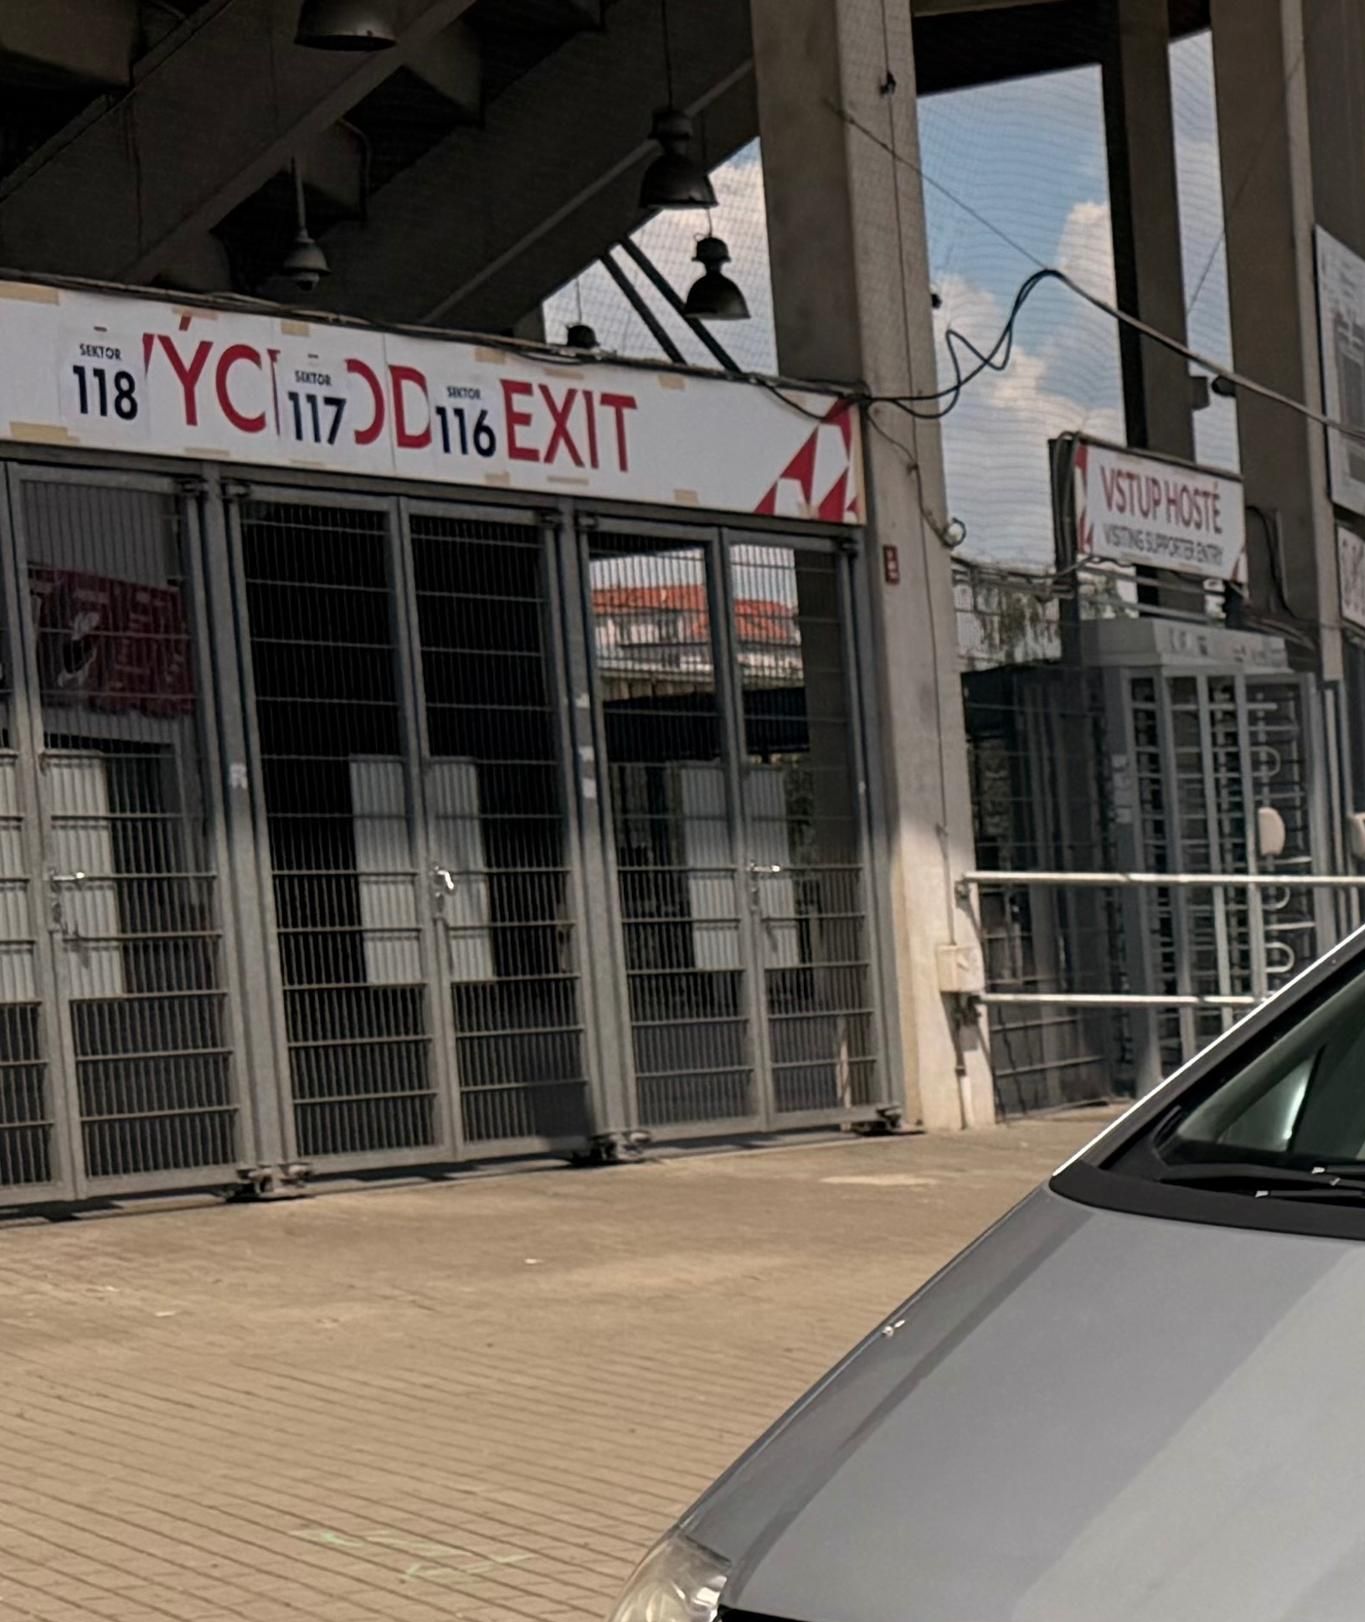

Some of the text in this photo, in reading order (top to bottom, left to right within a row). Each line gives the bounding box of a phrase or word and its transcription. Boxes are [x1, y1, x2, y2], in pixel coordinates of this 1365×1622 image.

[80, 343, 122, 361] SEKTOR
[295, 370, 332, 387] SEKTOR
[73, 364, 138, 421] 118
[288, 391, 346, 445] 117
[435, 405, 496, 458] 116
[500, 378, 637, 472] EXIT
[1100, 465, 1223, 535] VSTUP HOSTÉ
